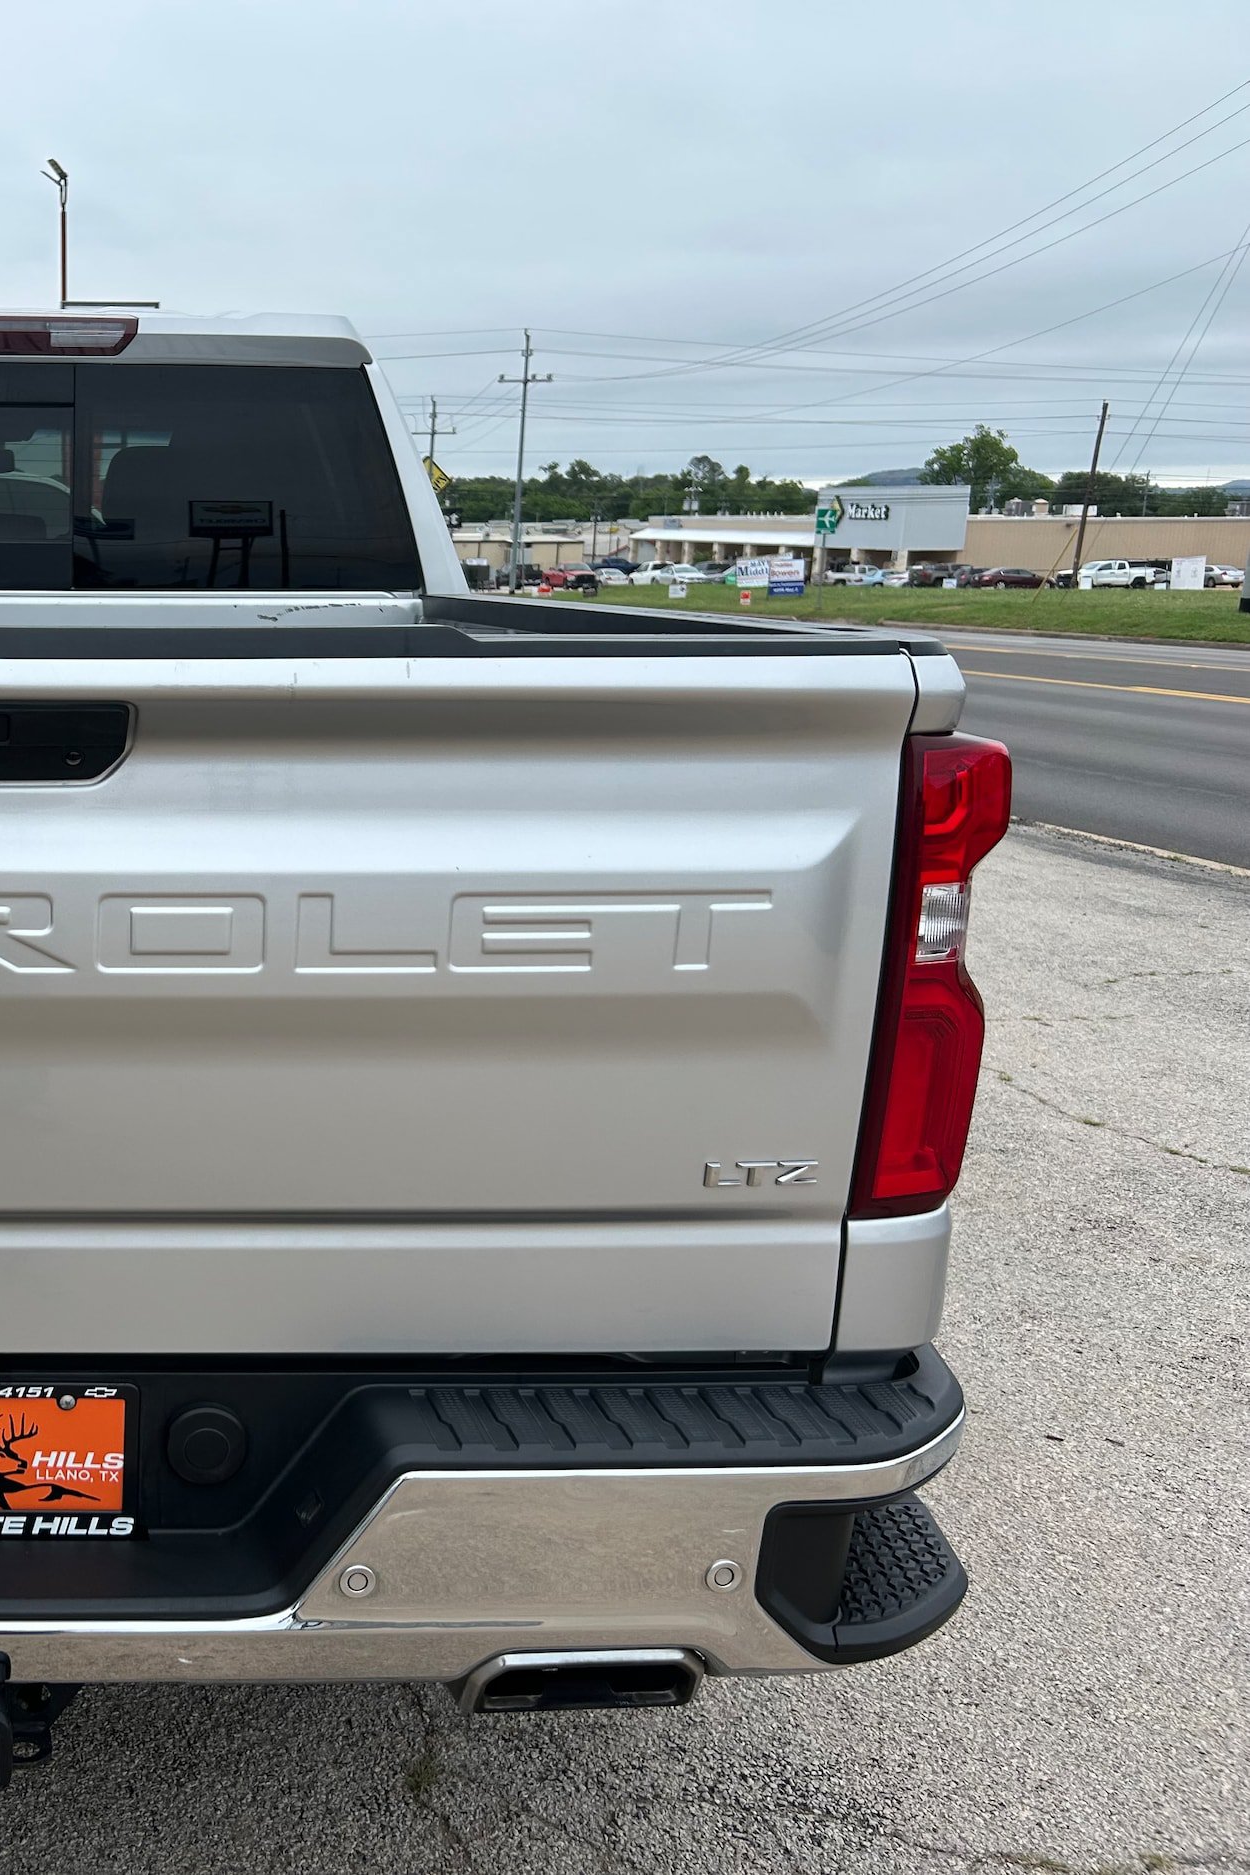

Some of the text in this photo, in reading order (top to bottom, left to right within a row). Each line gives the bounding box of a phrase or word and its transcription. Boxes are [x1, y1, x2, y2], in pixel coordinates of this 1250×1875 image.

[847, 503, 889, 520] Market
[703, 1160, 819, 1187] LTZ
[31, 1450, 124, 1469] HILLS
[36, 1469, 119, 1483] LLANO, TX
[31, 1517, 135, 1536] HILLS
